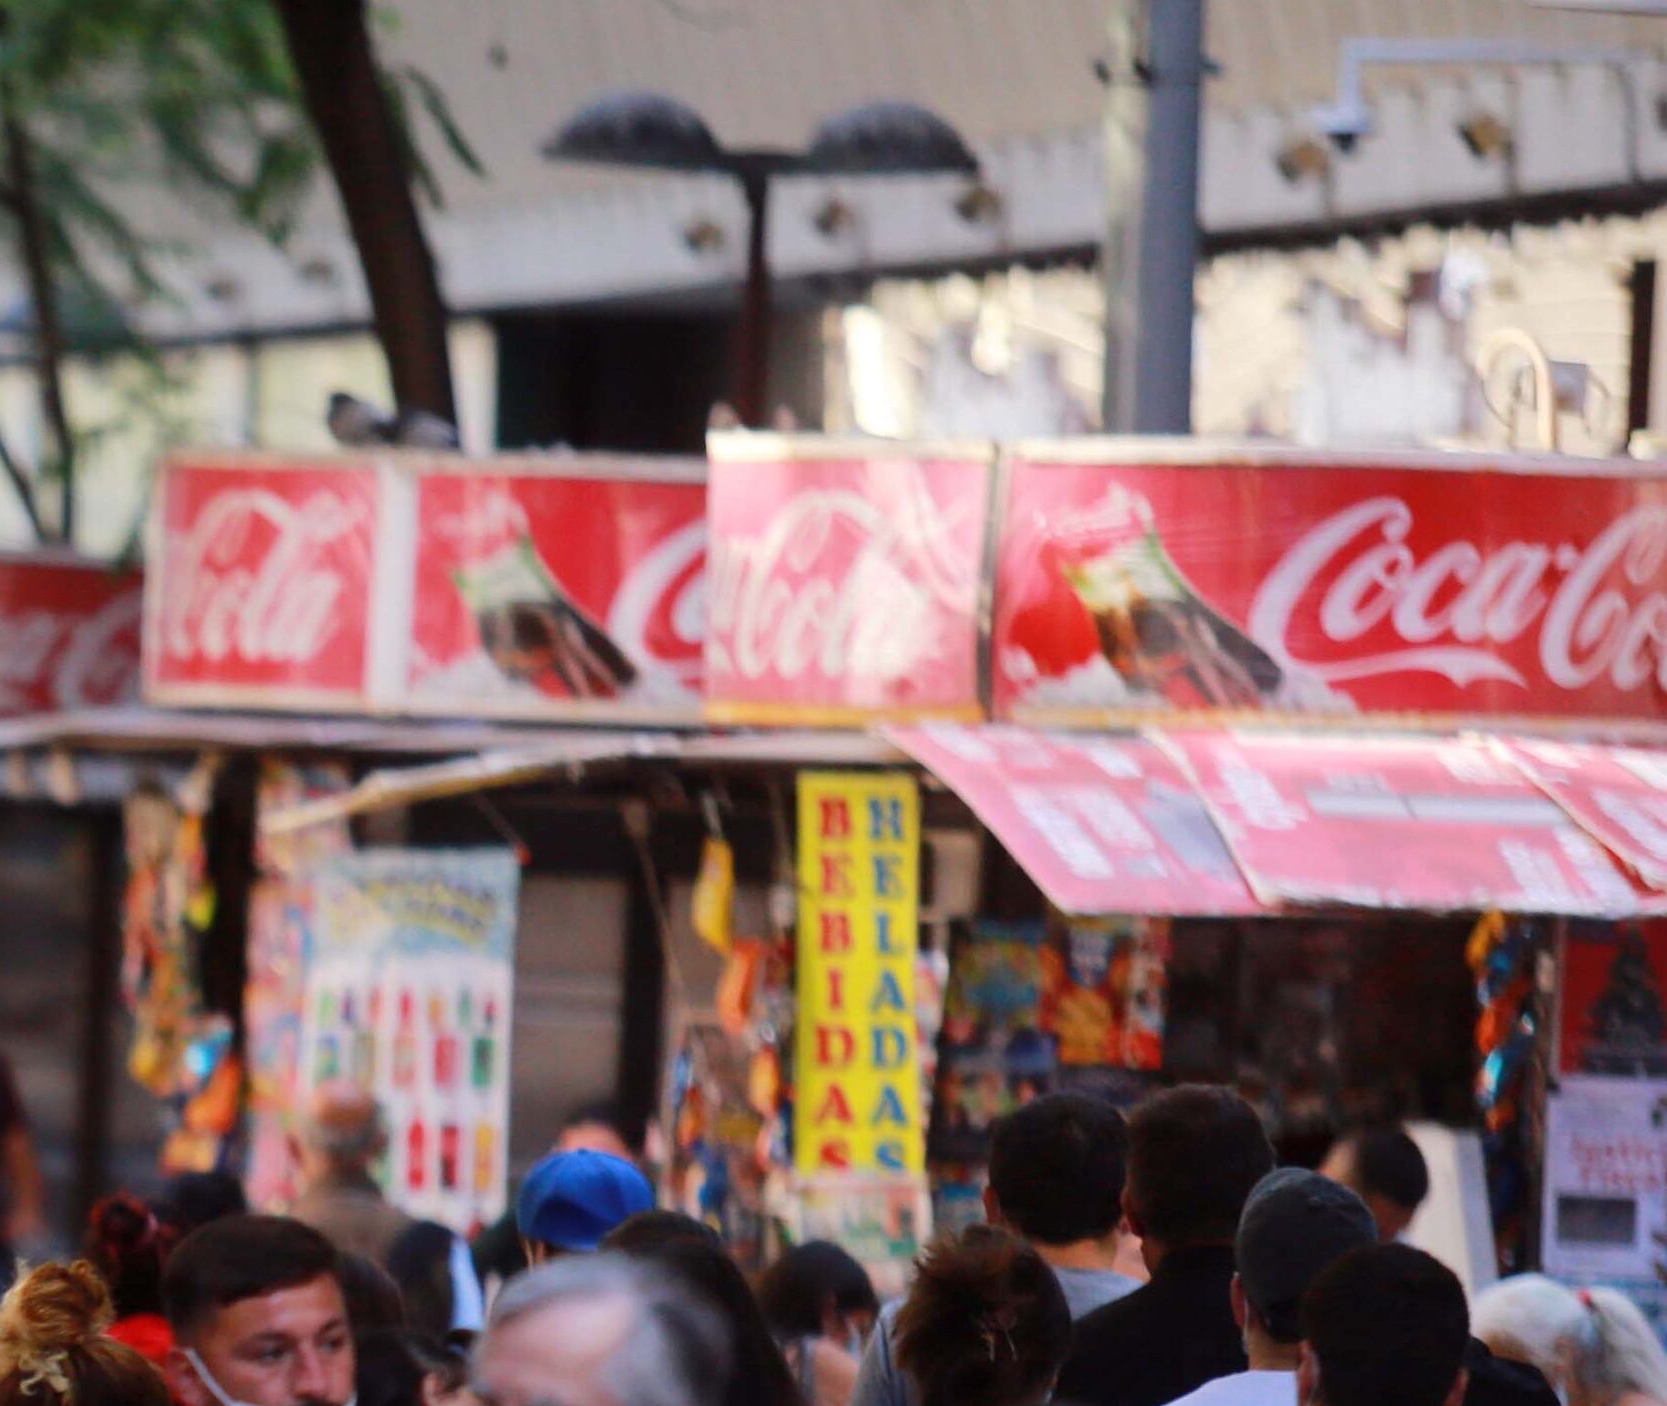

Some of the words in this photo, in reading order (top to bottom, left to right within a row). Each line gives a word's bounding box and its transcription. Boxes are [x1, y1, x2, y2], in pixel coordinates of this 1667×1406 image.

[1247, 496, 1667, 692] Coca-Co
[814, 796, 856, 1170] BEBIDAS
[869, 797, 908, 1171] HELADAS
